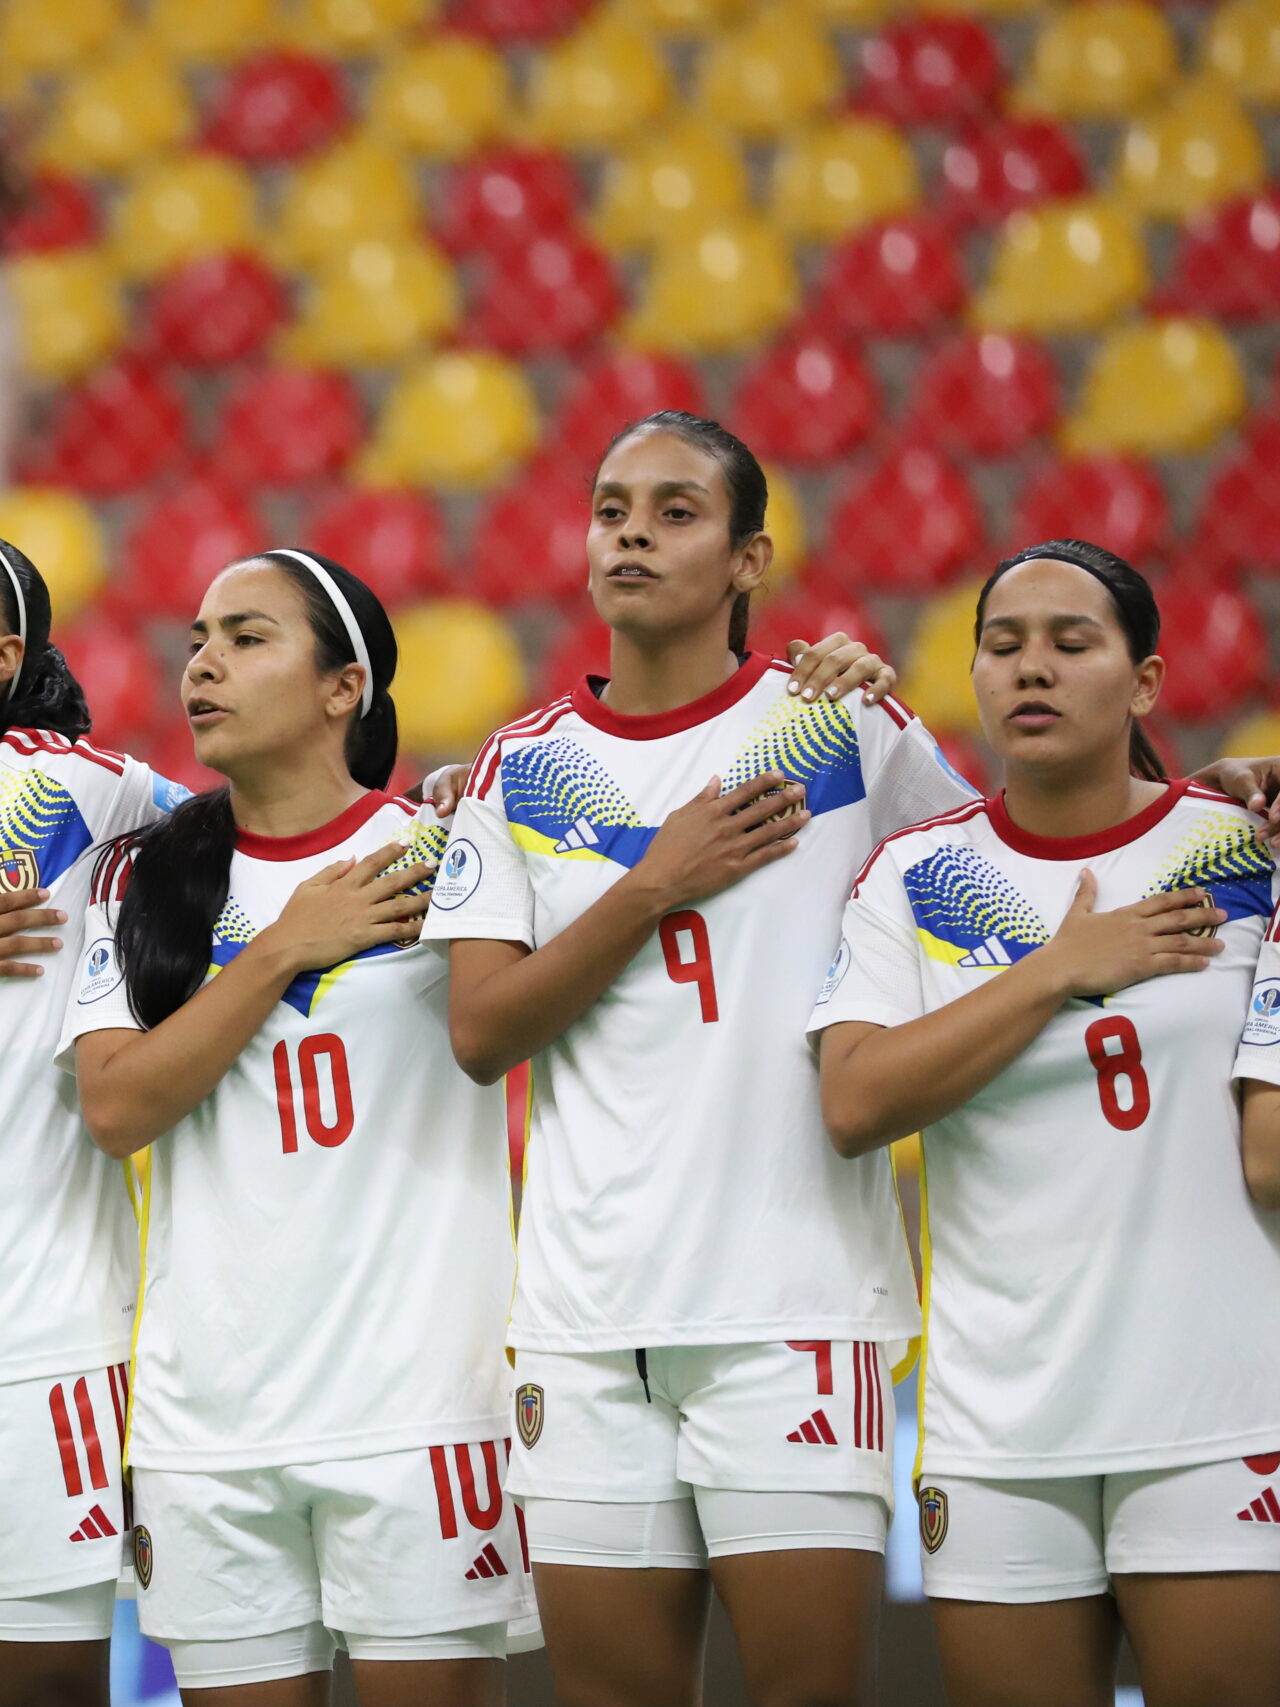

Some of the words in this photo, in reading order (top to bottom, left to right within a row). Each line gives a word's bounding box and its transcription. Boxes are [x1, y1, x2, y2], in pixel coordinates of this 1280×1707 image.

[662, 914, 719, 1023] 9
[273, 1034, 355, 1154] 10
[1086, 1016, 1150, 1131] 8
[49, 1377, 109, 1497] 11
